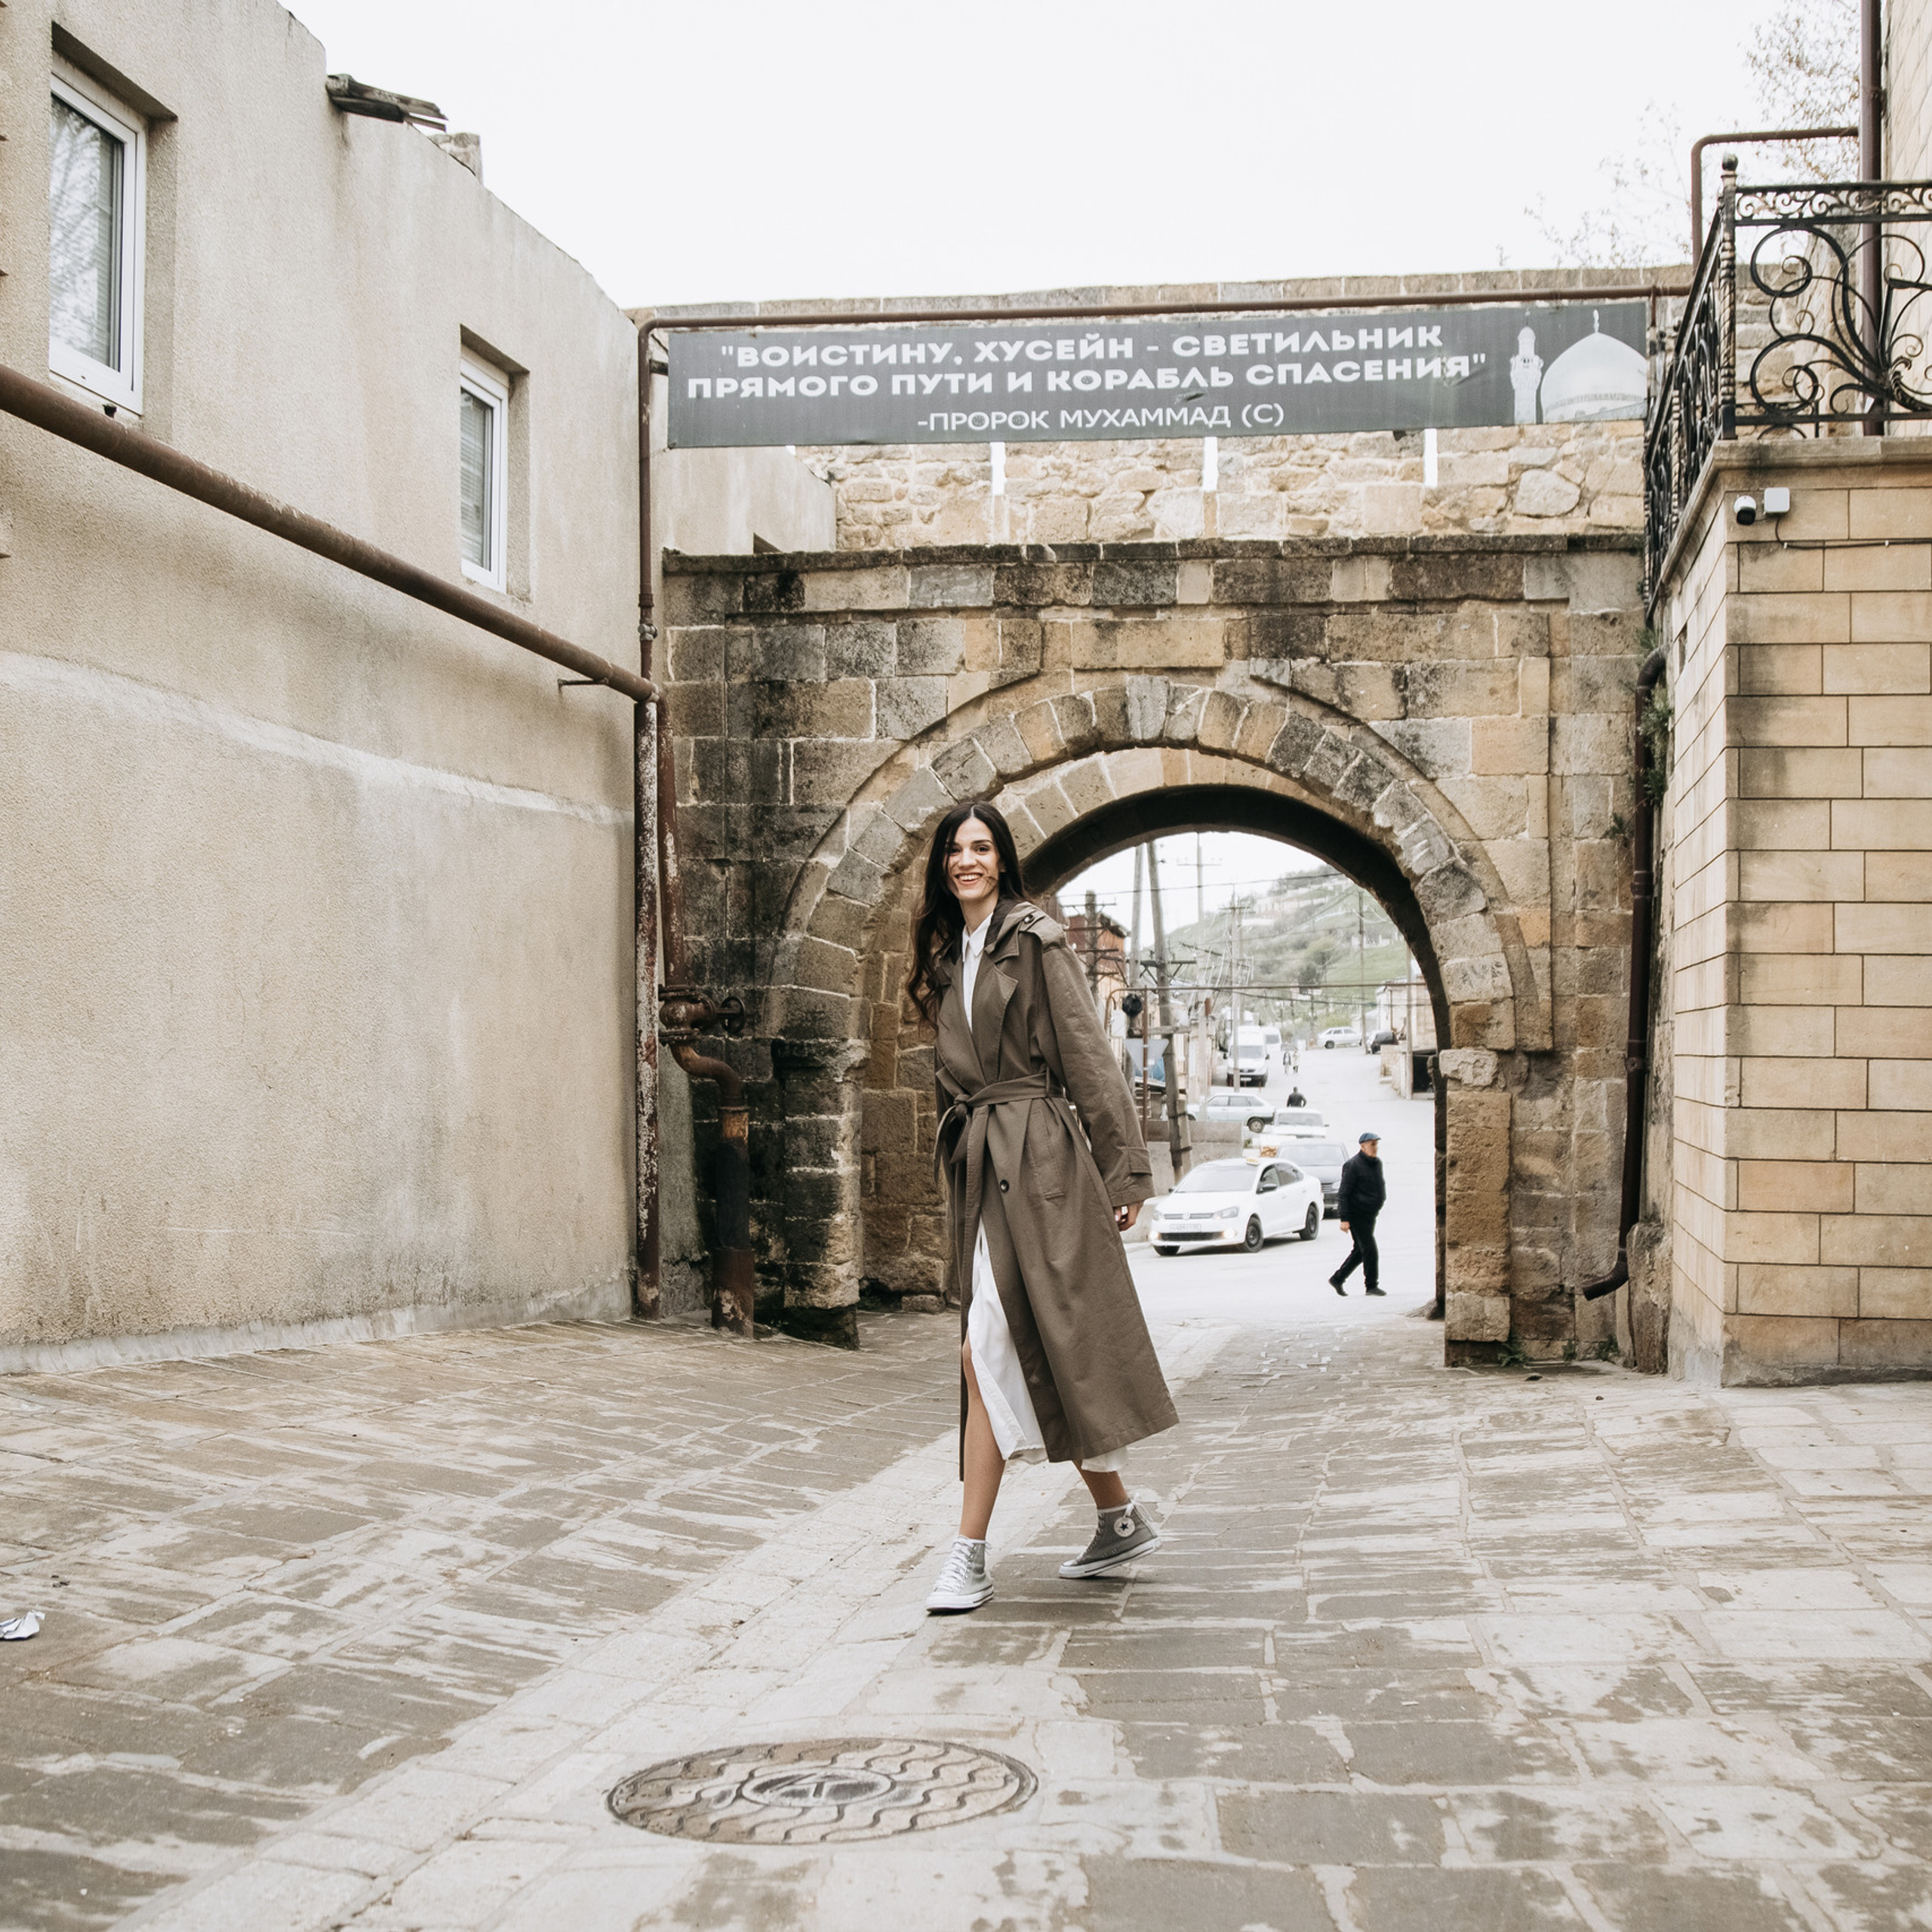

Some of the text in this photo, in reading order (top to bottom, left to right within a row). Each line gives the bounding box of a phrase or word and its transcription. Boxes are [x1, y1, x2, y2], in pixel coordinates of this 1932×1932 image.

[719, 341, 963, 368] "ВОИСТИНУ,
[974, 332, 1133, 364] ХУСЕЙН
[1172, 325, 1444, 358] СВЕТИЛЬНИК
[688, 352, 1486, 398] ПРЯМОГО ПУТИ И КОРАБЛЬ СПАСЕНИЯ"
[917, 410, 1050, 432] -ПРОРОК
[1060, 405, 1232, 429] МУХАММАД
